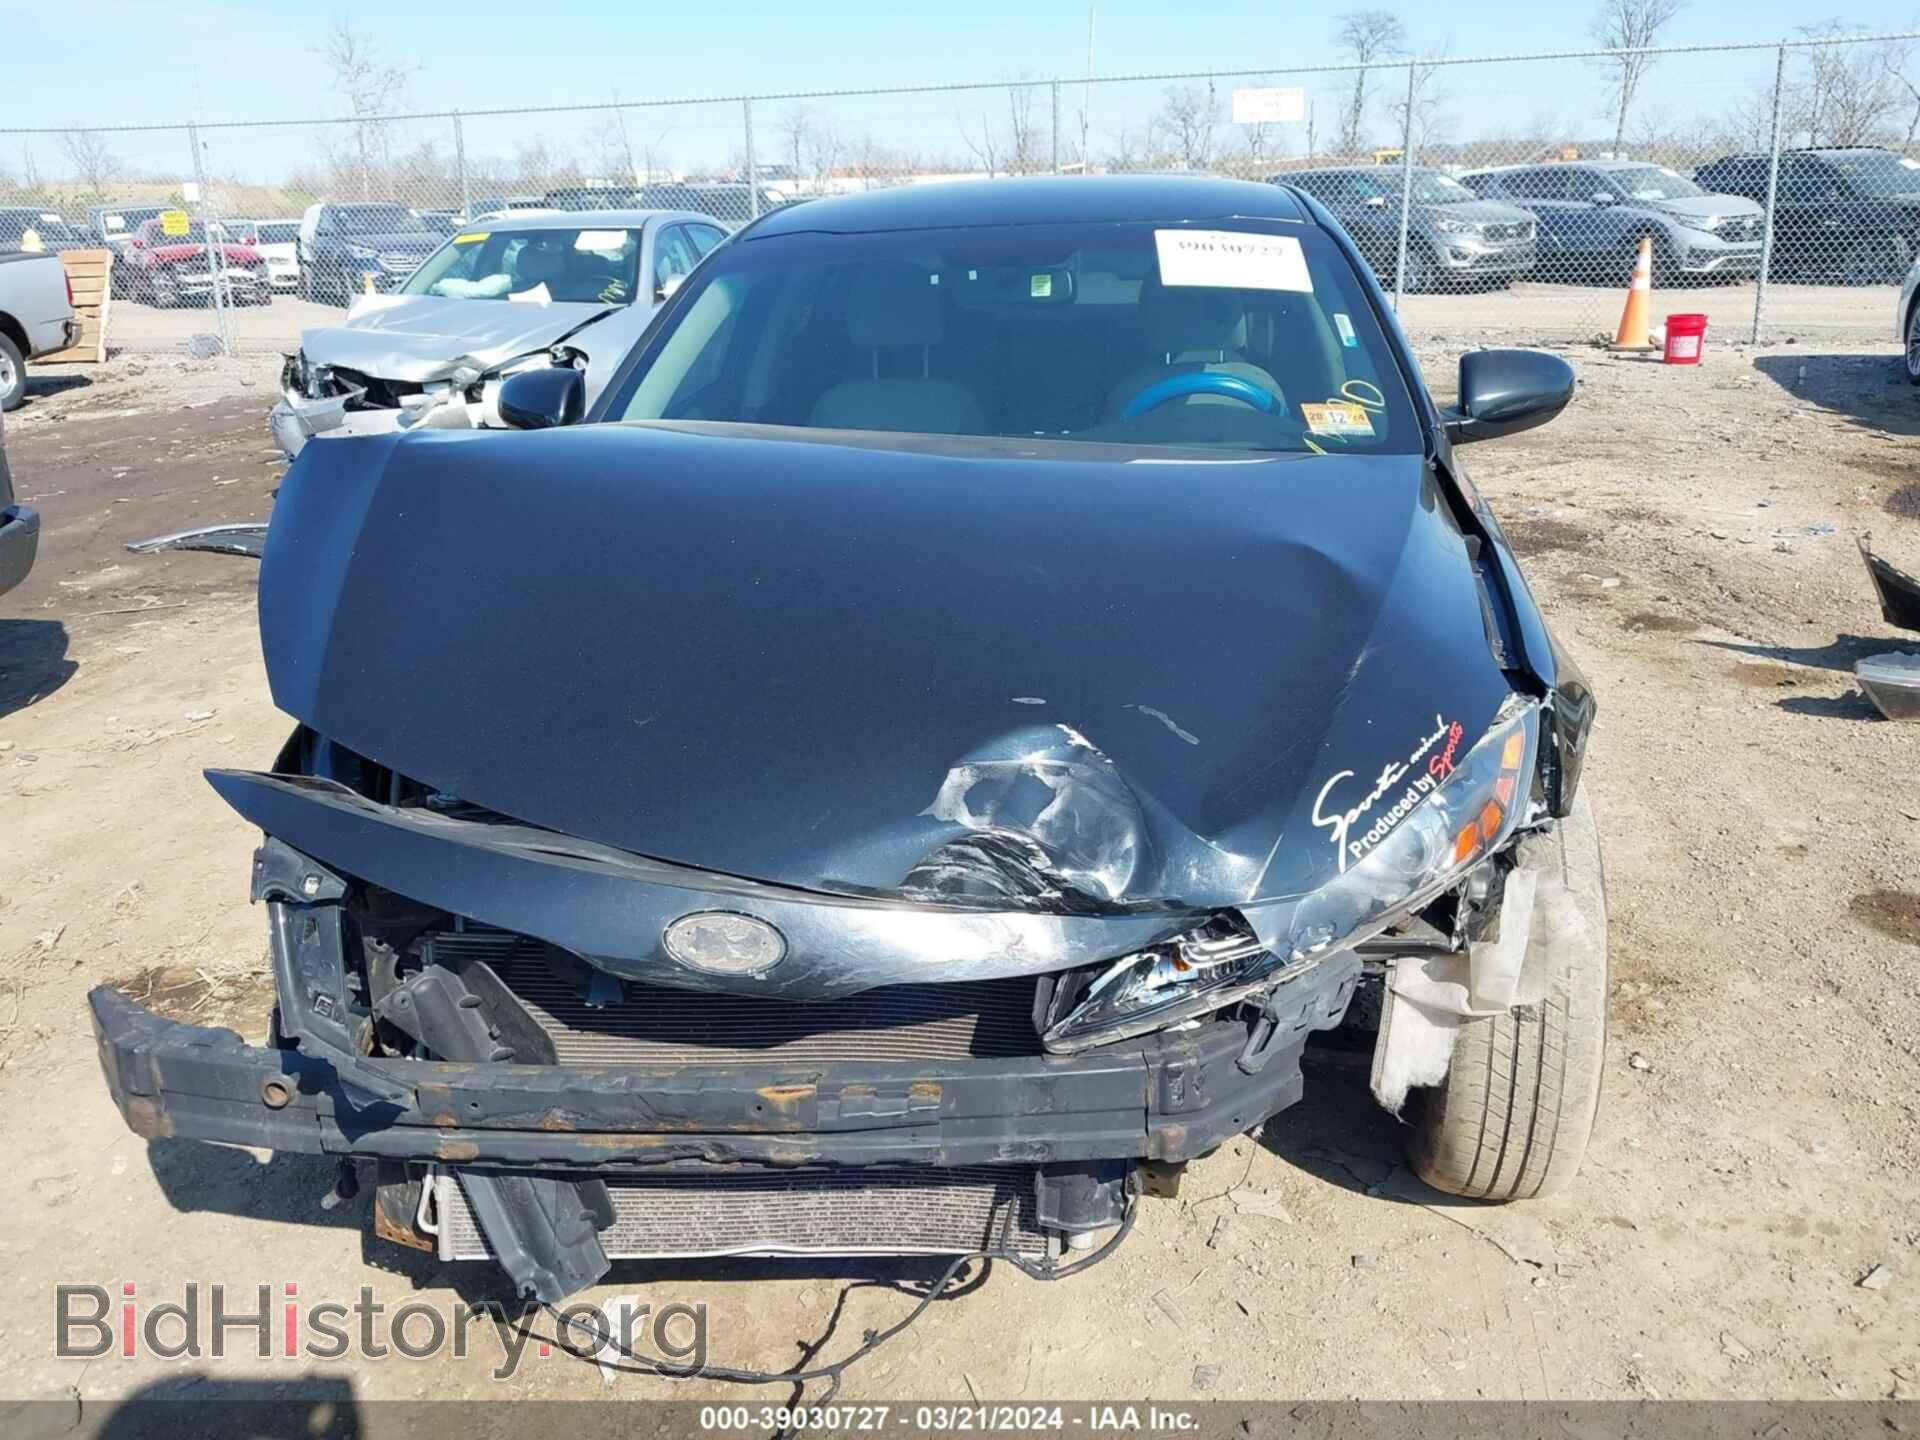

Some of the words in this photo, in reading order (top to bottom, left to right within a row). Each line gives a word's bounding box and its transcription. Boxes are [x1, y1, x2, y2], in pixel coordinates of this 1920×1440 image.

[1348, 788, 1421, 858] Produced
[1413, 772, 1437, 792] by
[1428, 721, 1464, 780] Sports
